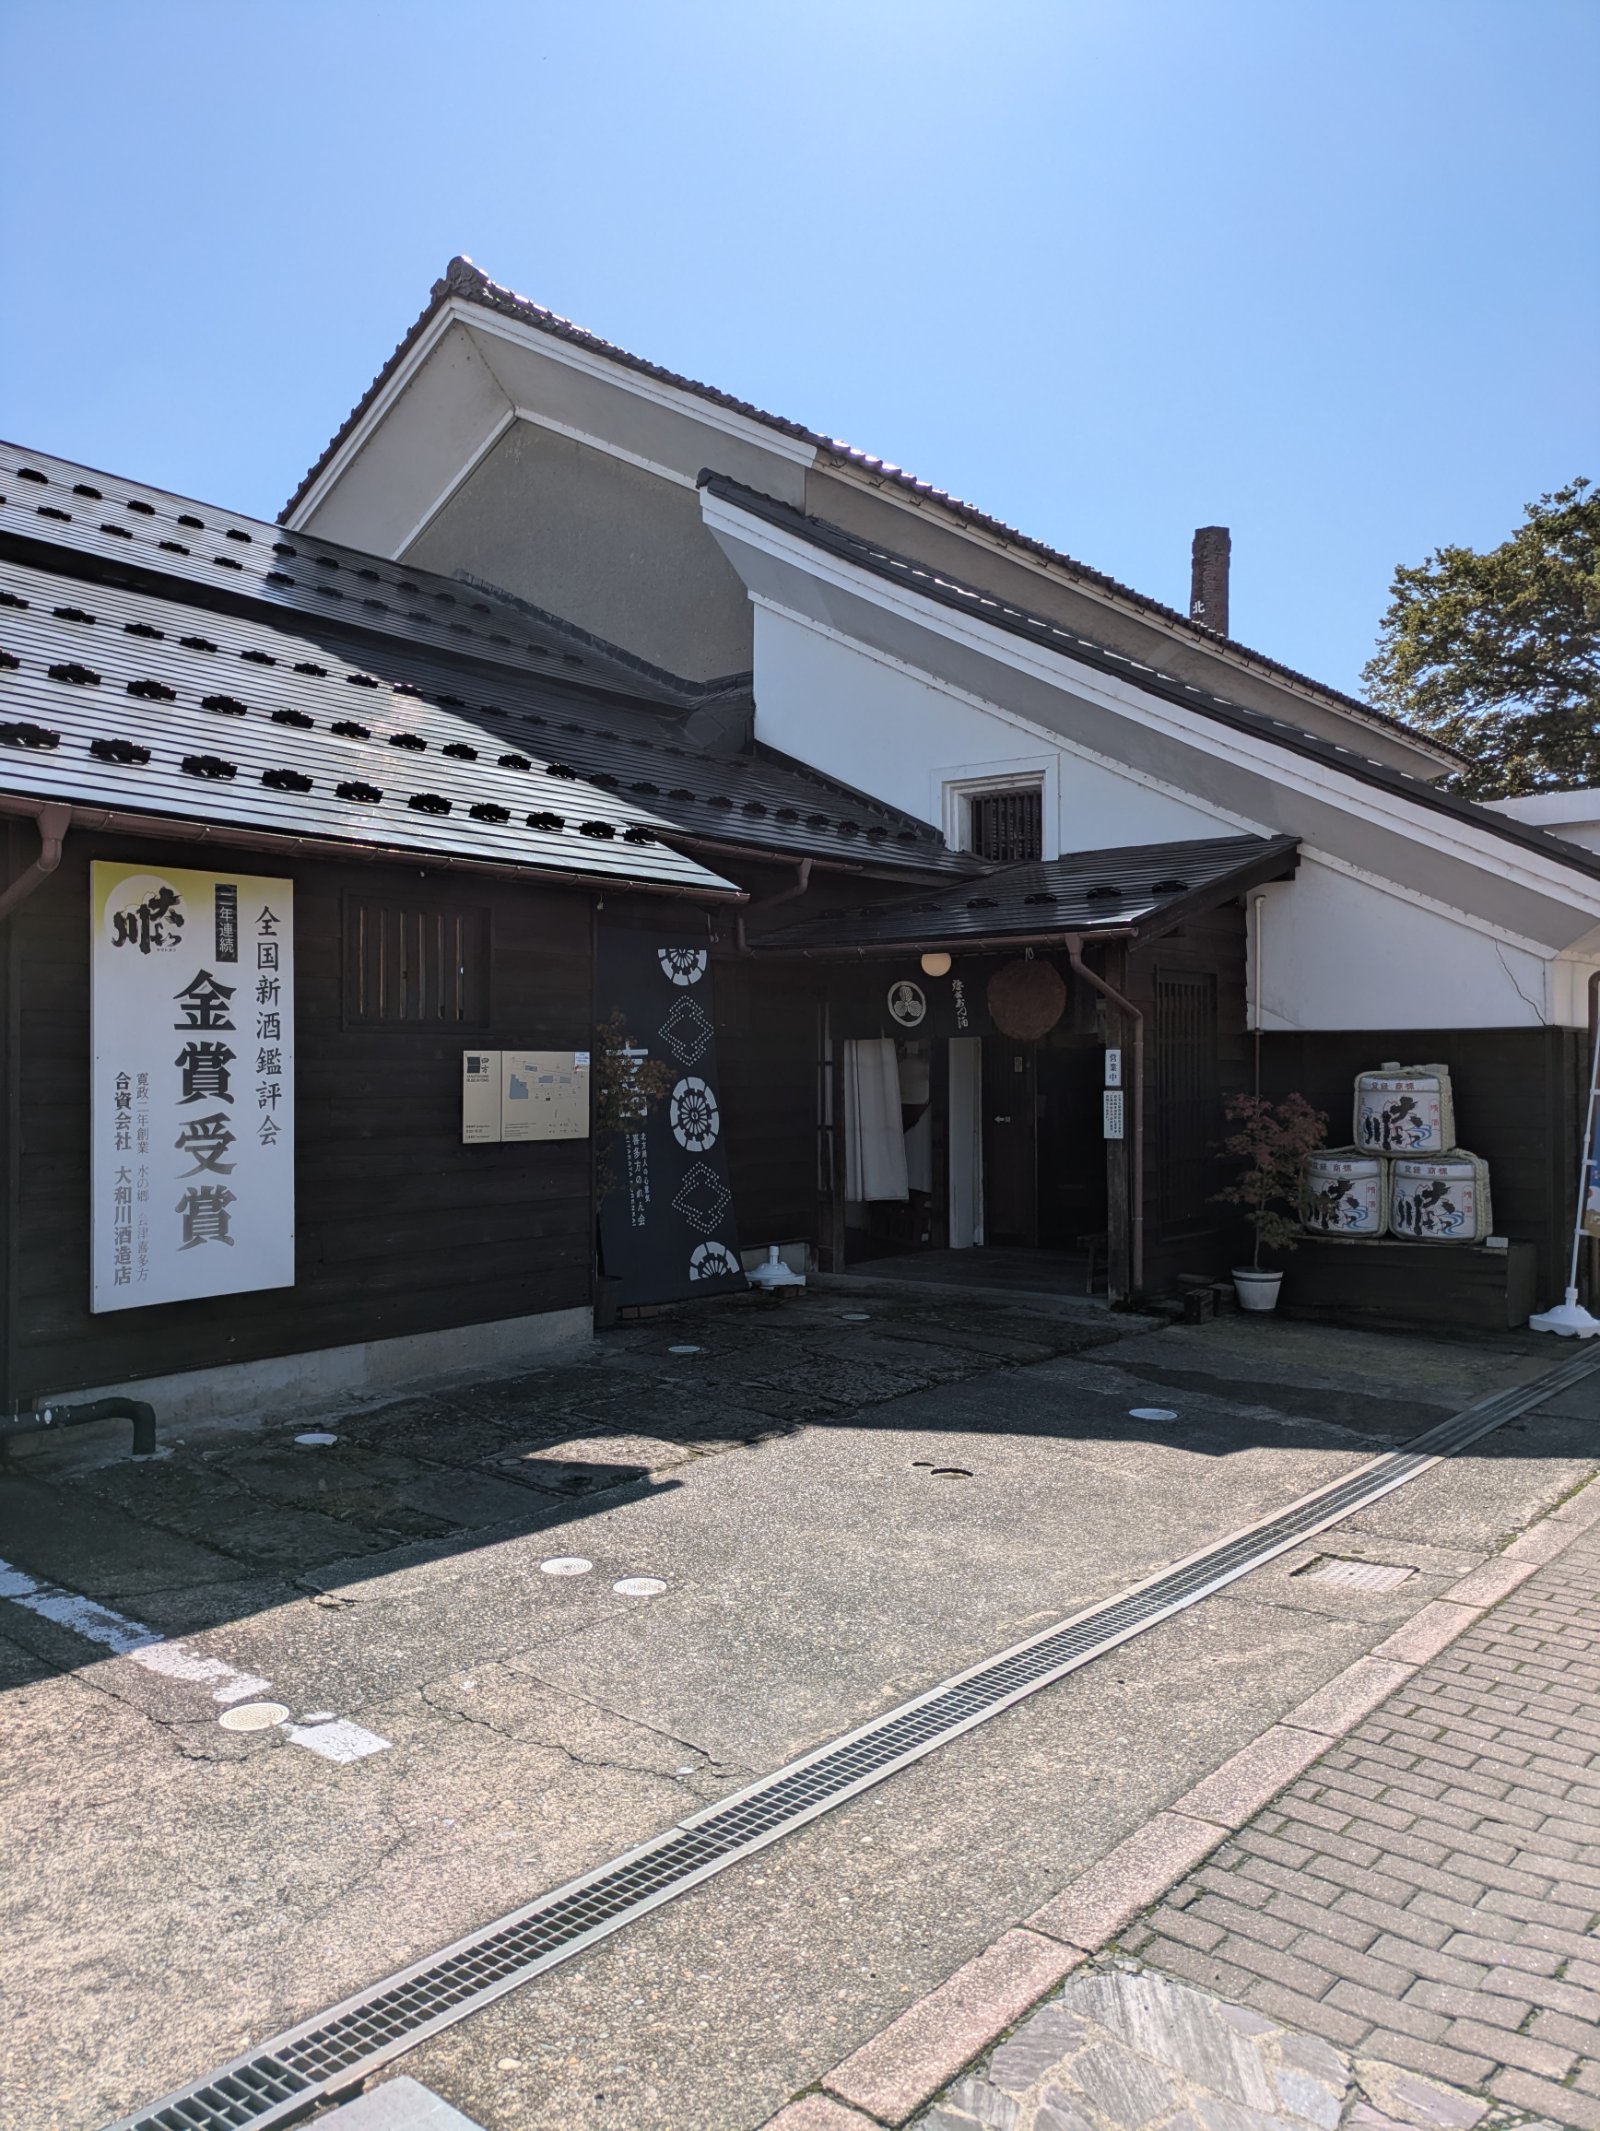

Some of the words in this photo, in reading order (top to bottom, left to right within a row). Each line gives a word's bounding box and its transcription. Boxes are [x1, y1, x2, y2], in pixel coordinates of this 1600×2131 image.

[218, 891, 235, 953] 二年連続
[254, 905, 283, 1147] 全国新酒鑑評会
[1109, 1053, 1117, 1082] 営業中
[114, 1071, 132, 1152] 合資会社
[172, 968, 239, 1252] 金賞受賞
[113, 1165, 133, 1287] 大和川酒造店
[136, 1212, 150, 1283] 会津喜多方
